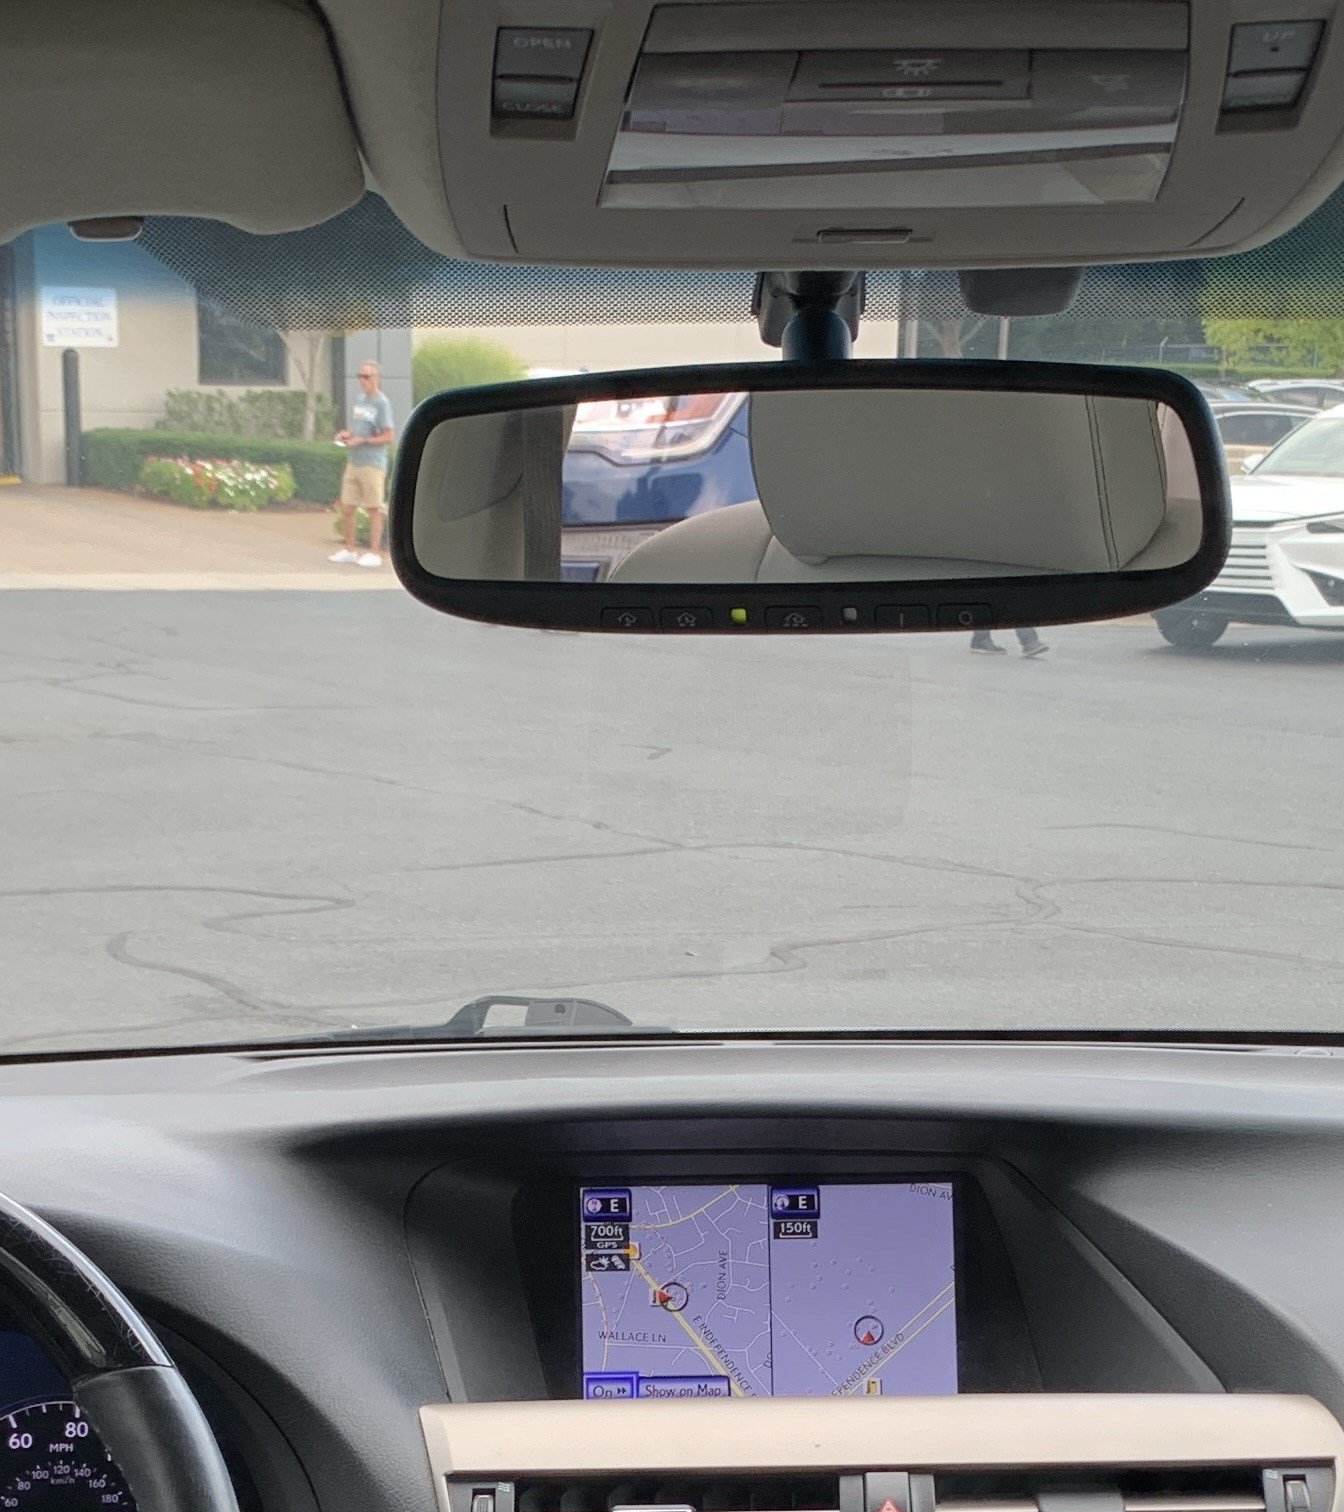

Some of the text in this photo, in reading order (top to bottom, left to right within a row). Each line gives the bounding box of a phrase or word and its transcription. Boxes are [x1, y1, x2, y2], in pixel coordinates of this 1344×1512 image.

[1263, 31, 1296, 42] UP
[513, 37, 571, 48] OPEN
[909, 1183, 937, 1198] DION
[610, 1199, 619, 1212] E
[798, 1196, 807, 1209] E
[591, 1225, 623, 1237] 700ft
[780, 1222, 811, 1234] 150ft
[716, 1249, 729, 1300] DION AVE
[598, 1331, 667, 1342] WALLACE LN
[881, 1332, 905, 1355] BLVD
[699, 1322, 752, 1393] INDEPENDENCE
[593, 1386, 613, 1398] On
[645, 1384, 721, 1398] Show on Map
[65, 1421, 89, 1437] 80
[8, 1433, 33, 1449] 60
[49, 1443, 74, 1453] MPH
[31, 1470, 49, 1480] 100
[53, 1464, 70, 1475] 120
[74, 1467, 92, 1478] 140
[17, 1481, 31, 1491] 80
[50, 1476, 75, 1485] km/h
[88, 1478, 106, 1489] 160
[4, 1497, 18, 1507] 60
[101, 1494, 118, 1504] 180
